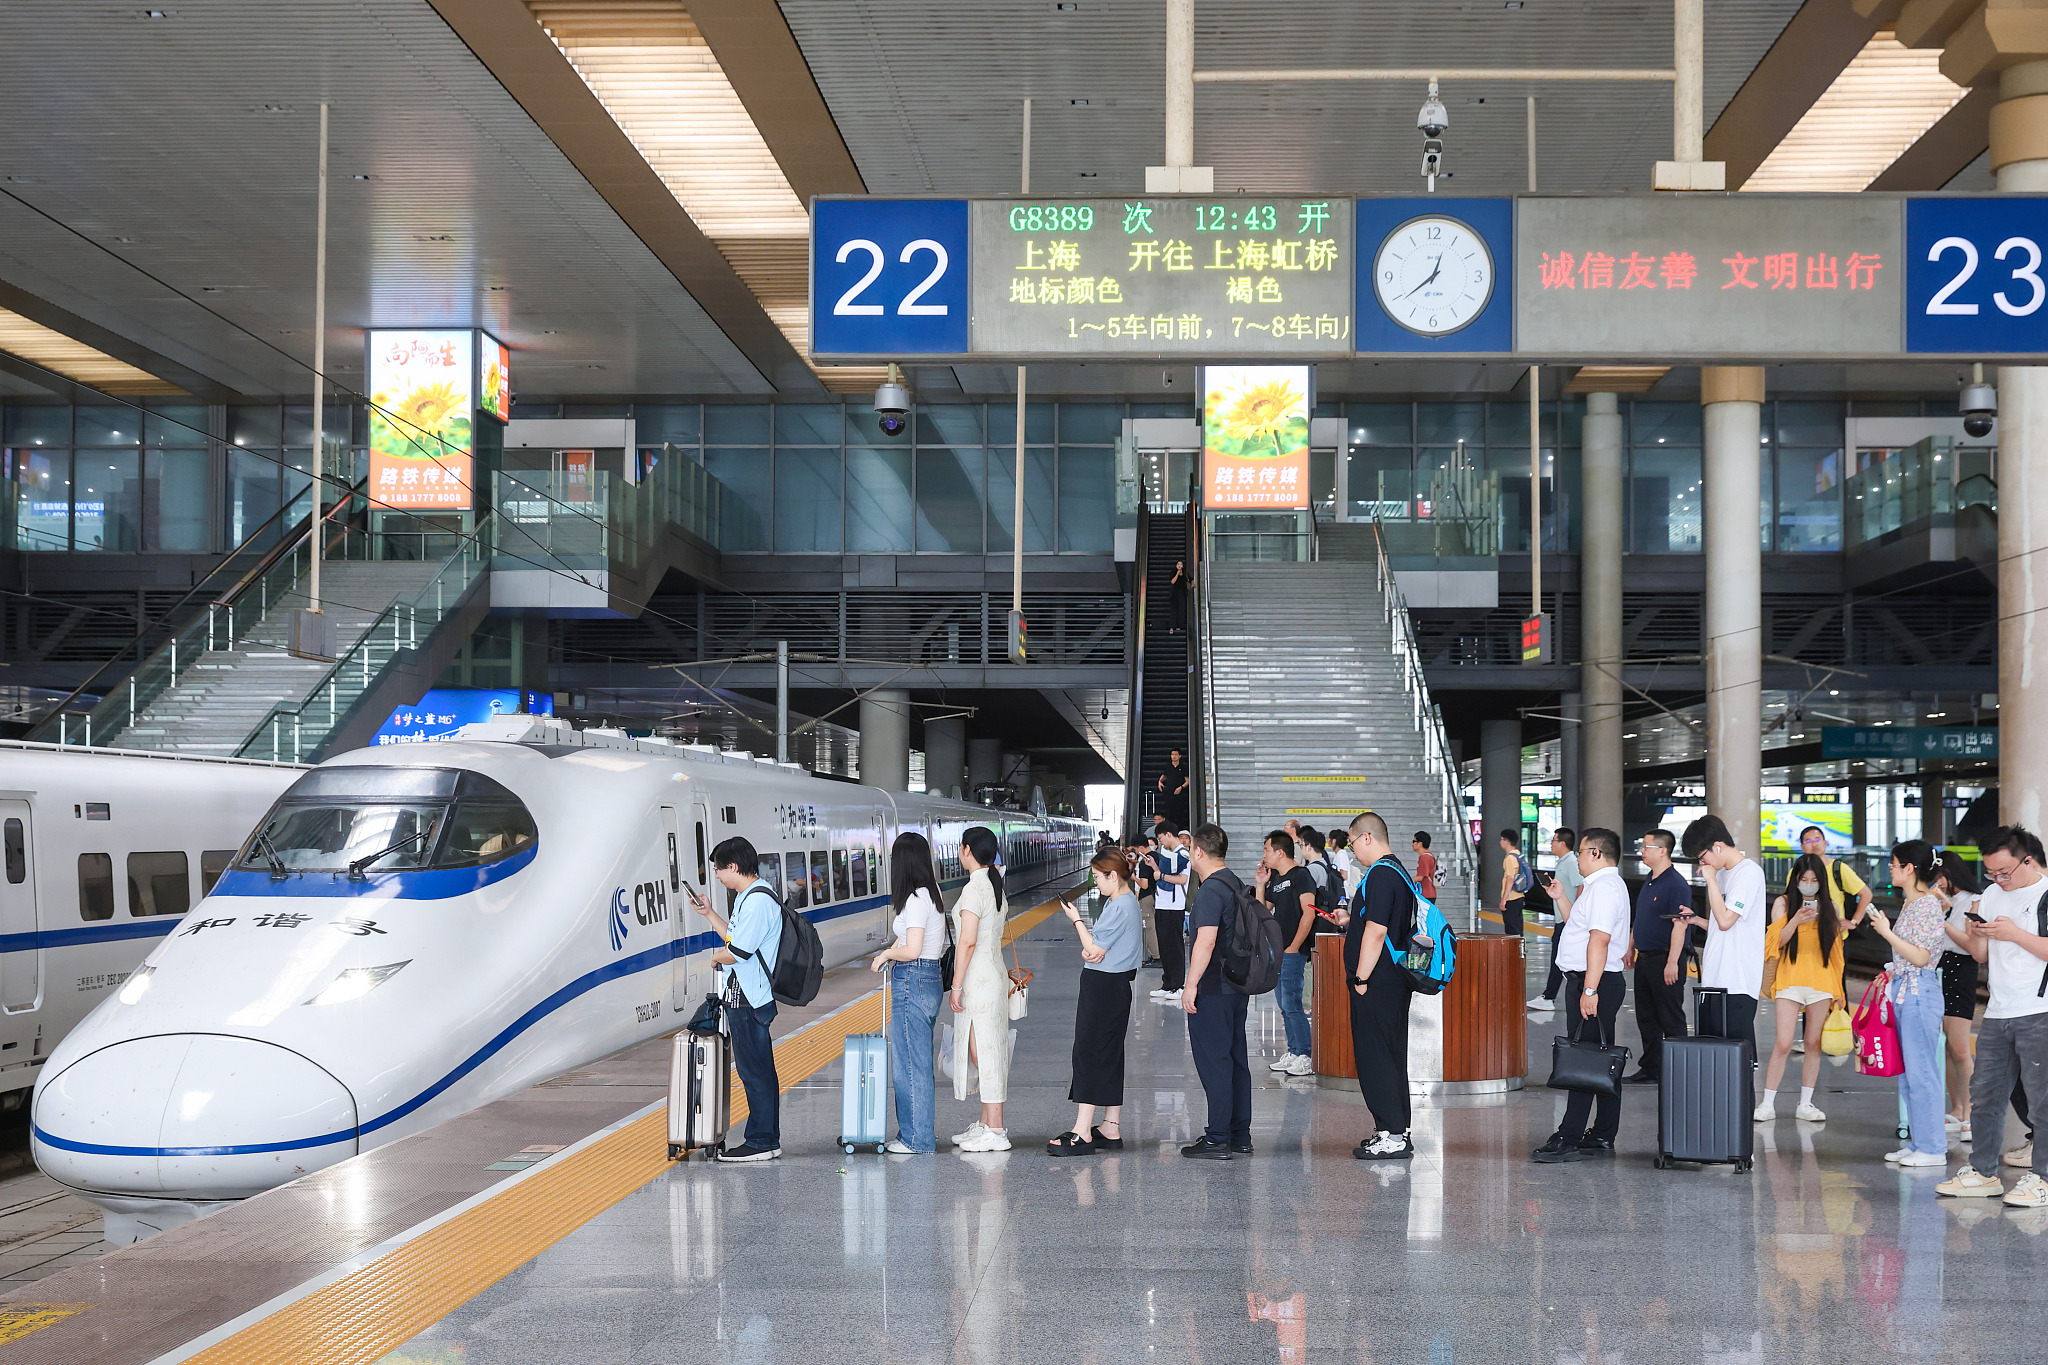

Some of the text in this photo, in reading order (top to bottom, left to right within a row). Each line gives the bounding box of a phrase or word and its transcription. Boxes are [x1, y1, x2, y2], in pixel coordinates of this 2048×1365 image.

[1009, 202, 1332, 235] G8389 次 12:43 开
[1427, 226, 1441, 240] 12
[1015, 239, 1338, 272] 上海 开往 上海虹桥
[833, 238, 949, 316] 22
[1384, 271, 1394, 284] 9
[1474, 270, 1483, 283] 3
[1538, 251, 1883, 290] 诚信友善 文明出行
[1925, 236, 2046, 317] 23
[1009, 276, 1284, 306] 地标颜色 褐色
[1429, 315, 1438, 328] 6
[379, 467, 462, 486] 路铁传媒
[1215, 466, 1298, 485] 路铁传媒
[391, 494, 461, 502] 188 1777 8008
[1226, 494, 1298, 502] 188 1777 8008
[1965, 732, 1994, 746] 出站
[634, 880, 668, 926] CRH
[178, 912, 388, 936] 和谐号
[1873, 1036, 1885, 1069] LOTSO
